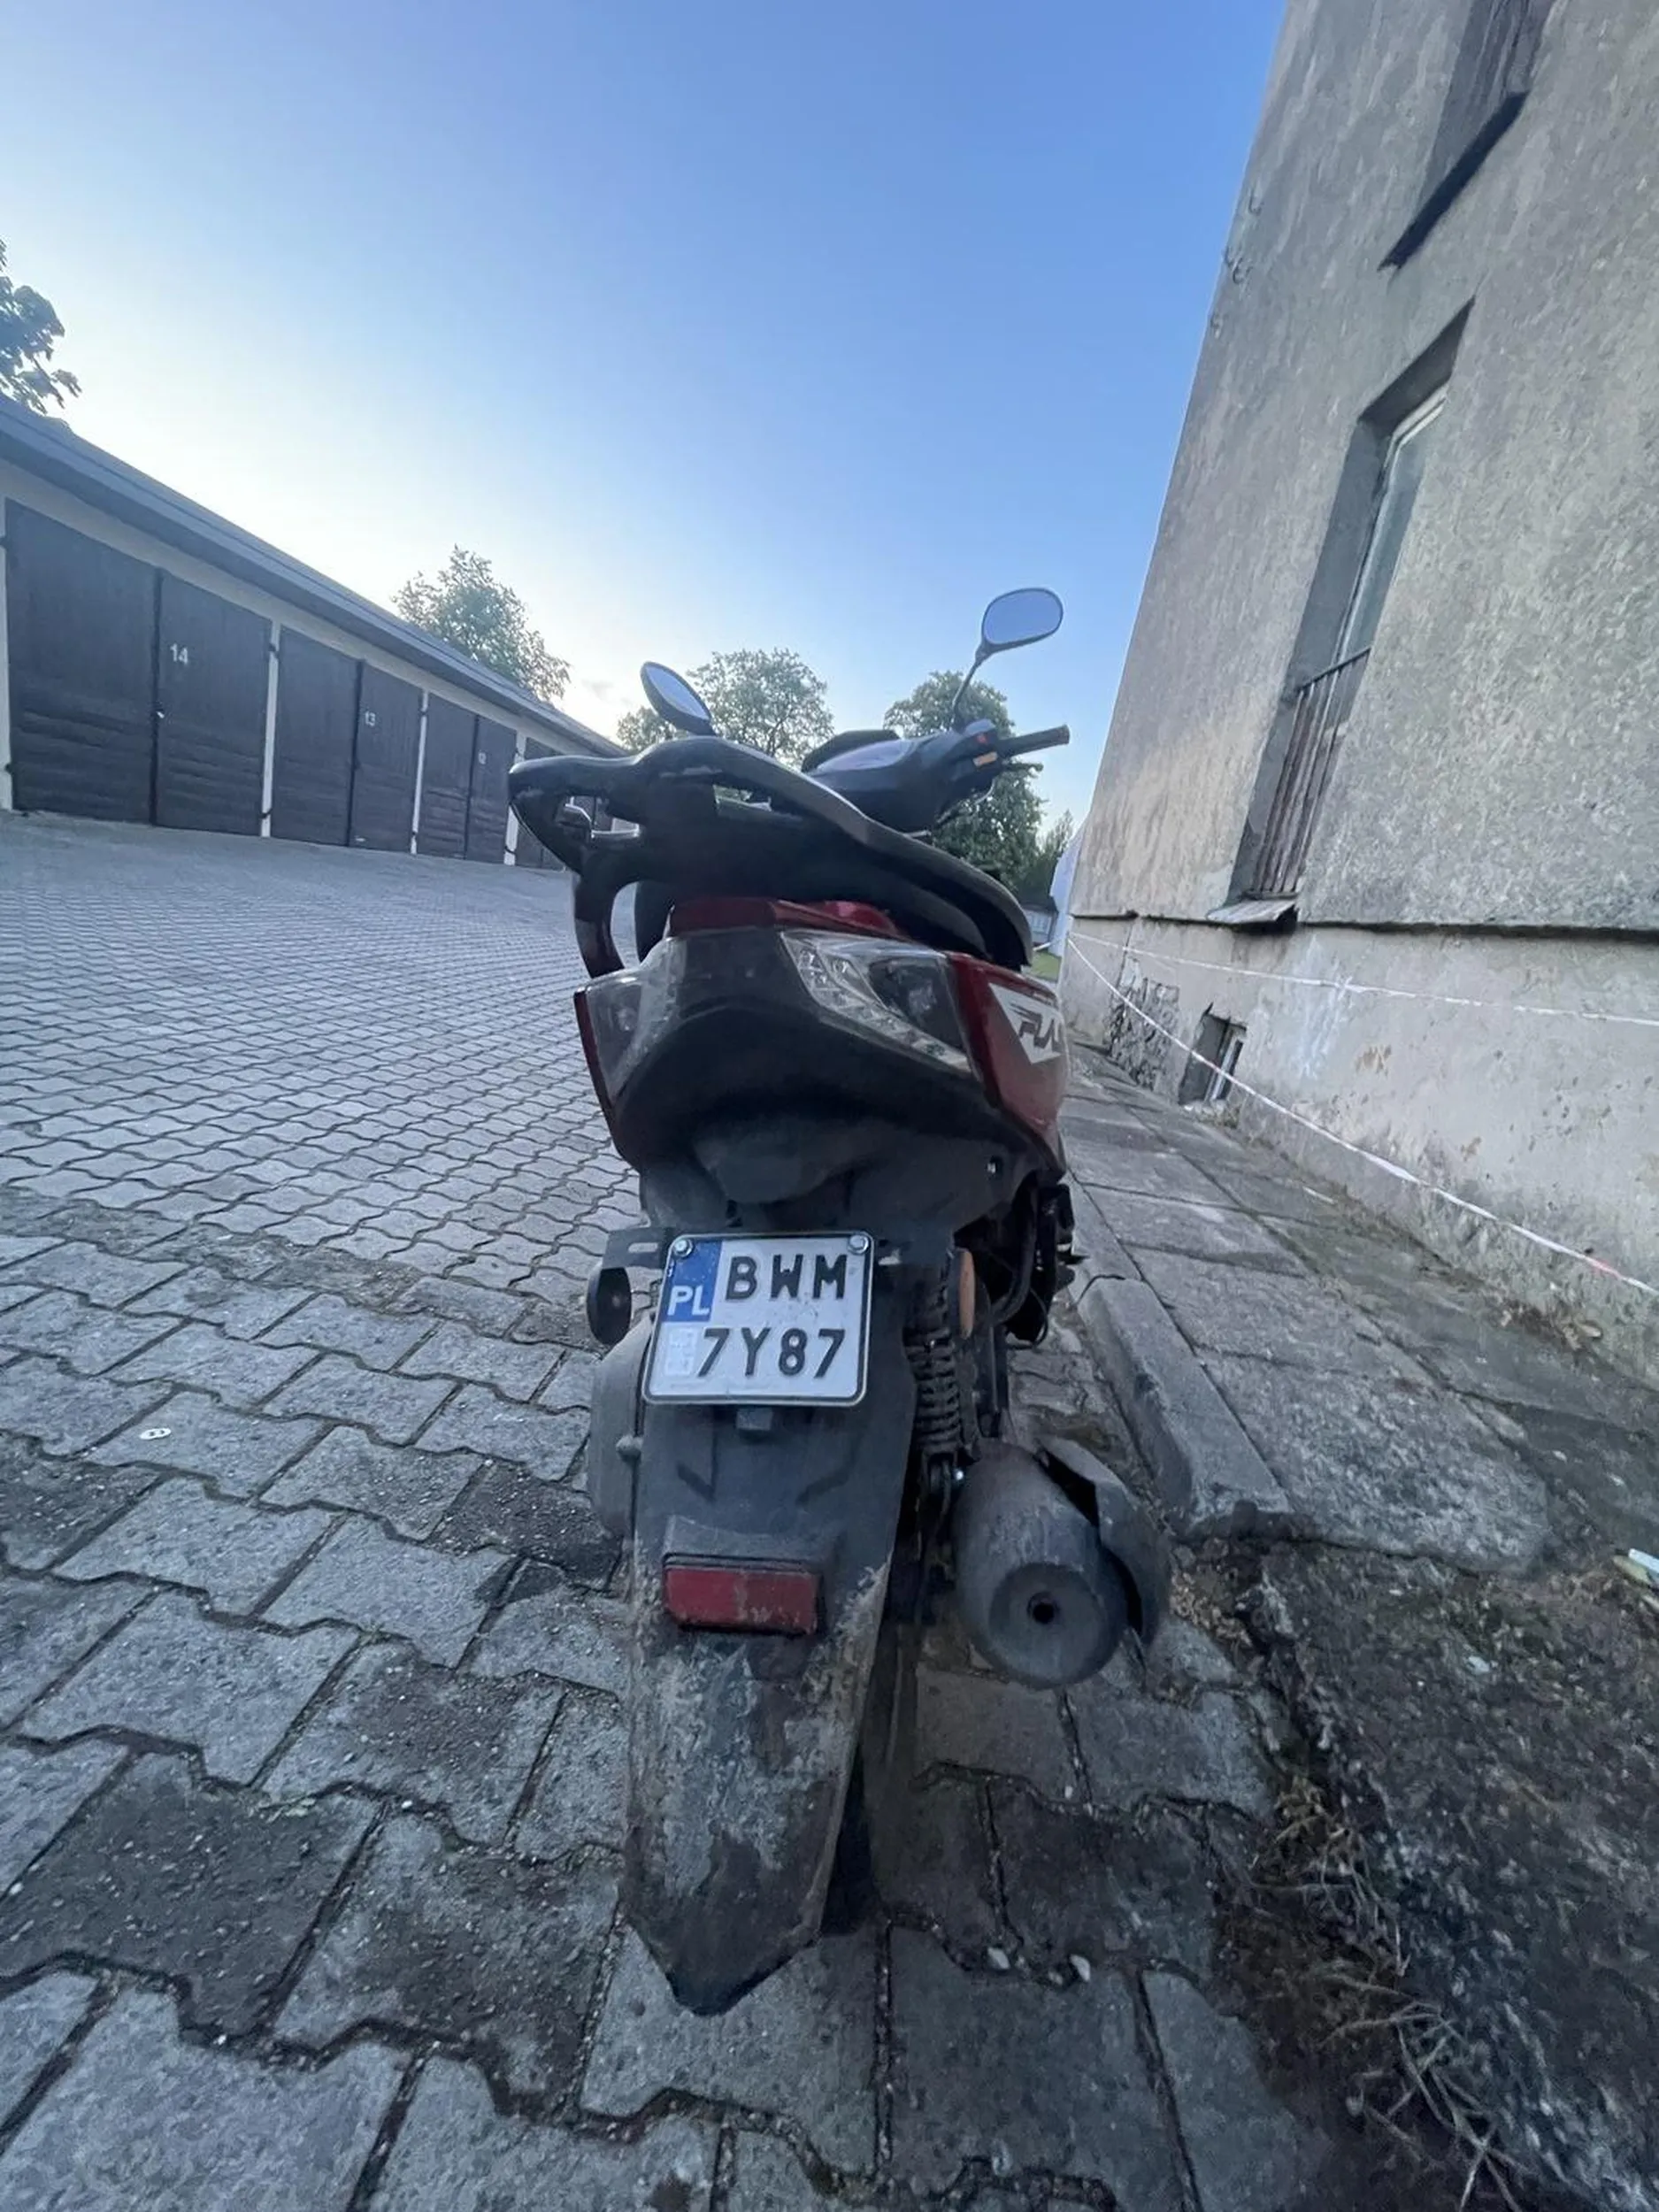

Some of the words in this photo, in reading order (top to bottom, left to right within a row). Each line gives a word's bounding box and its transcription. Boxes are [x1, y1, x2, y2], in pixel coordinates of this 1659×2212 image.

[169, 642, 188, 664] 14
[365, 710, 376, 726] 13
[725, 1254, 848, 1301] BWM
[666, 1285, 710, 1317] PL
[696, 1326, 846, 1379] 7Y87
